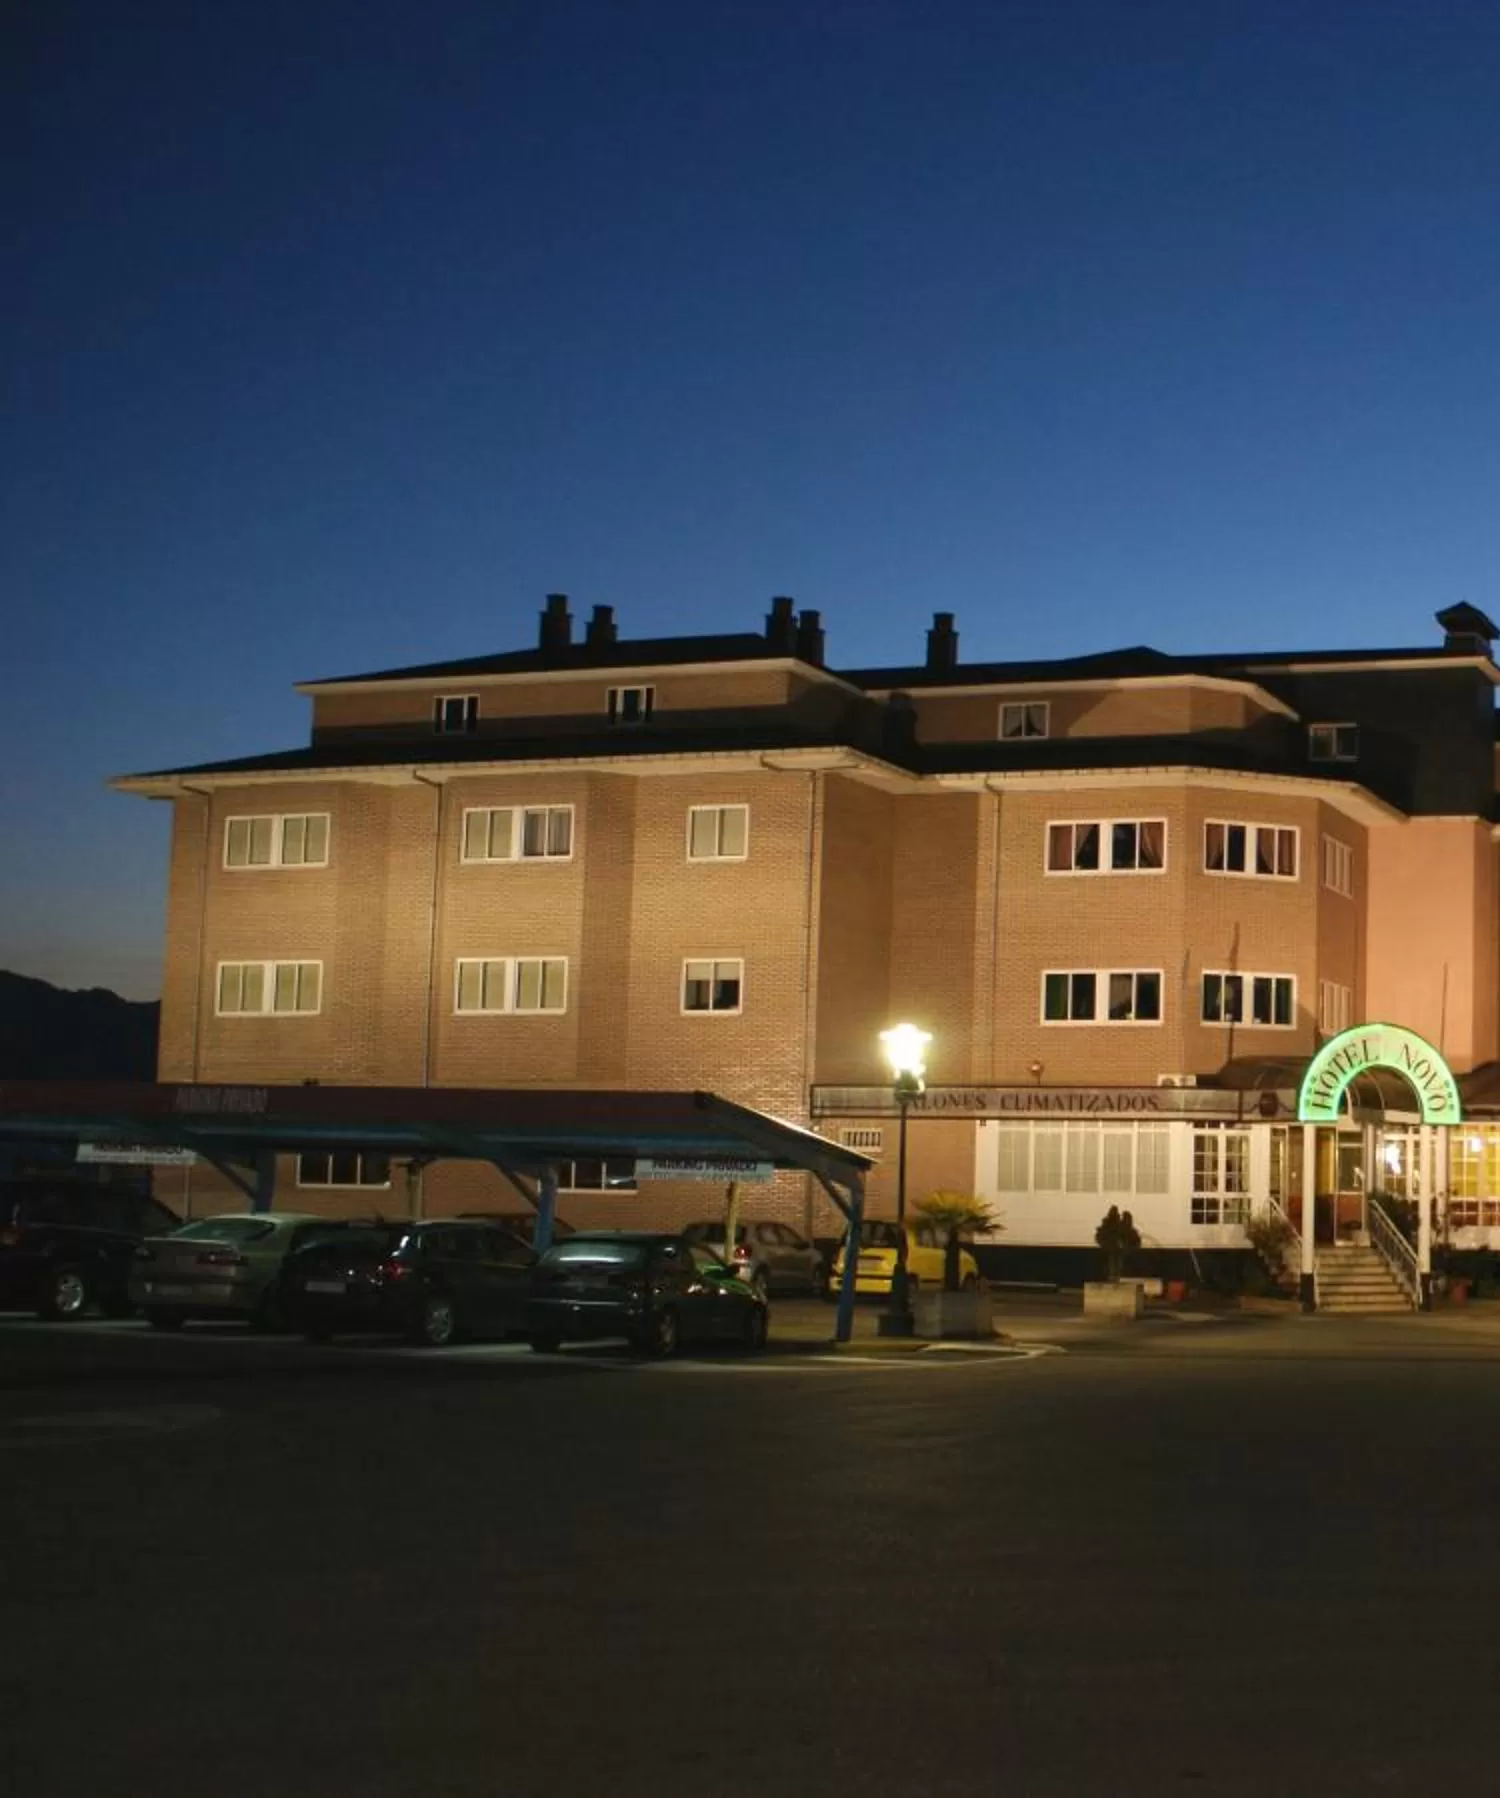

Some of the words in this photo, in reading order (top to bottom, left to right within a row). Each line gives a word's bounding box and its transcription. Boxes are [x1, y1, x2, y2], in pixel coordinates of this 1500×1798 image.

[1311, 1039, 1380, 1110] HOTEL
[1395, 1043, 1447, 1112] NOVO
[1000, 1093, 1160, 1113] CLIMATIZADOS
